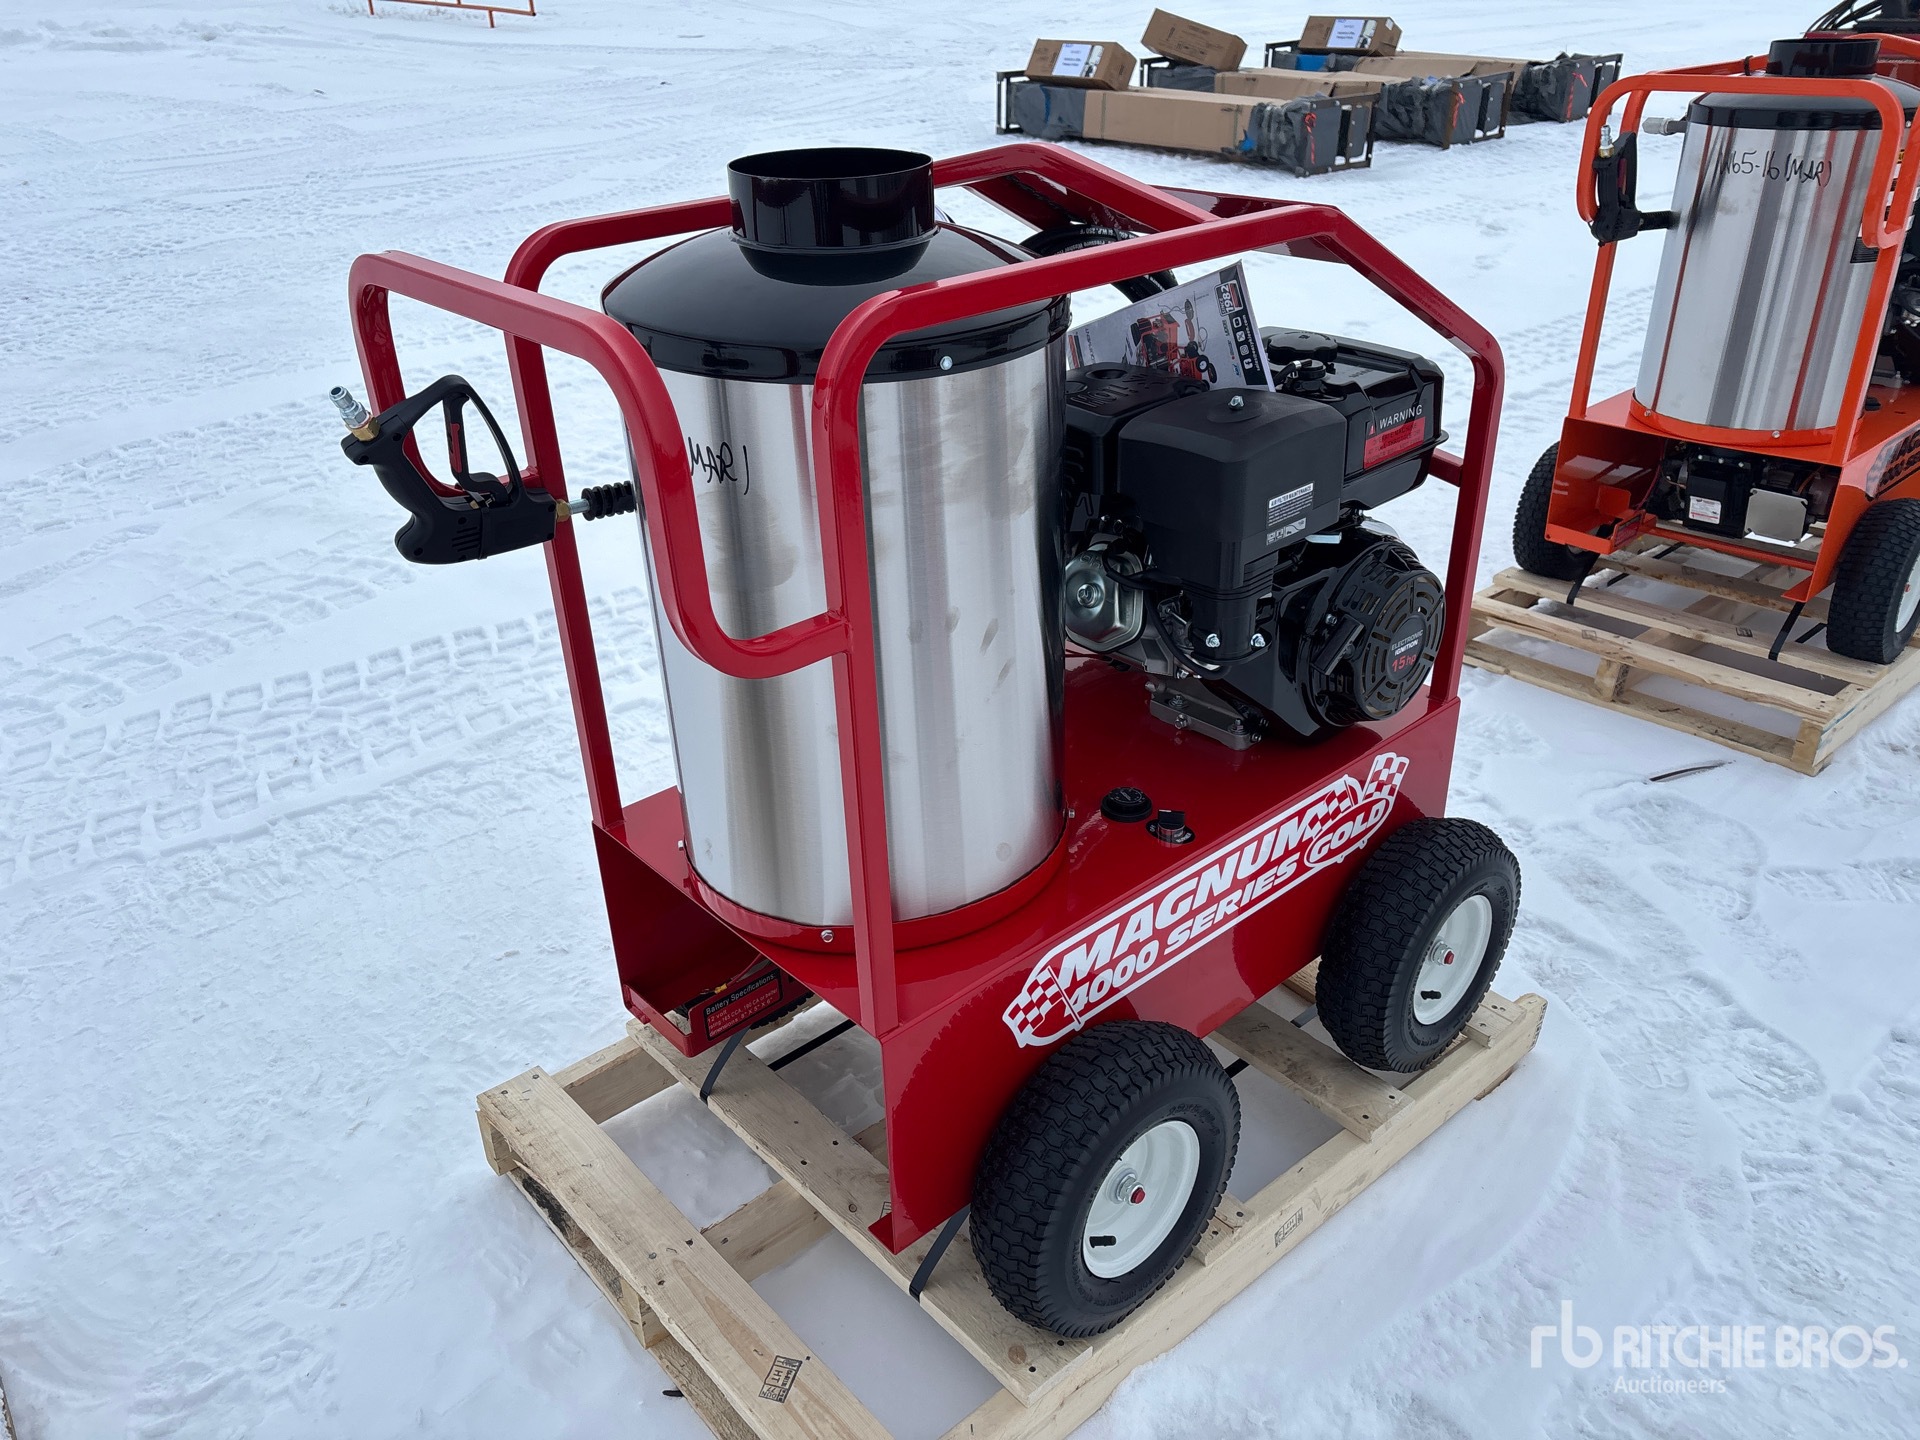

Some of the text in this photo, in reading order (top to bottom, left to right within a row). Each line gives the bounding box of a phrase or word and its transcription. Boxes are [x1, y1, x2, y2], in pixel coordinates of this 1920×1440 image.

[1085, 227, 1096, 235] 250
[1083, 240, 1106, 248] Pressure
[1220, 284, 1234, 313] 1982
[1379, 404, 1423, 430] WARNING
[1391, 629, 1424, 651] ELECTRONIC
[1394, 638, 1419, 656] IGNITION
[1310, 802, 1384, 859] GOLD
[1057, 801, 1330, 989] MAGNUM
[1065, 852, 1300, 1012] 4000 SERIES
[705, 998, 730, 1015] Battery
[707, 1009, 728, 1023] 12 volt
[771, 1369, 783, 1383] HT
